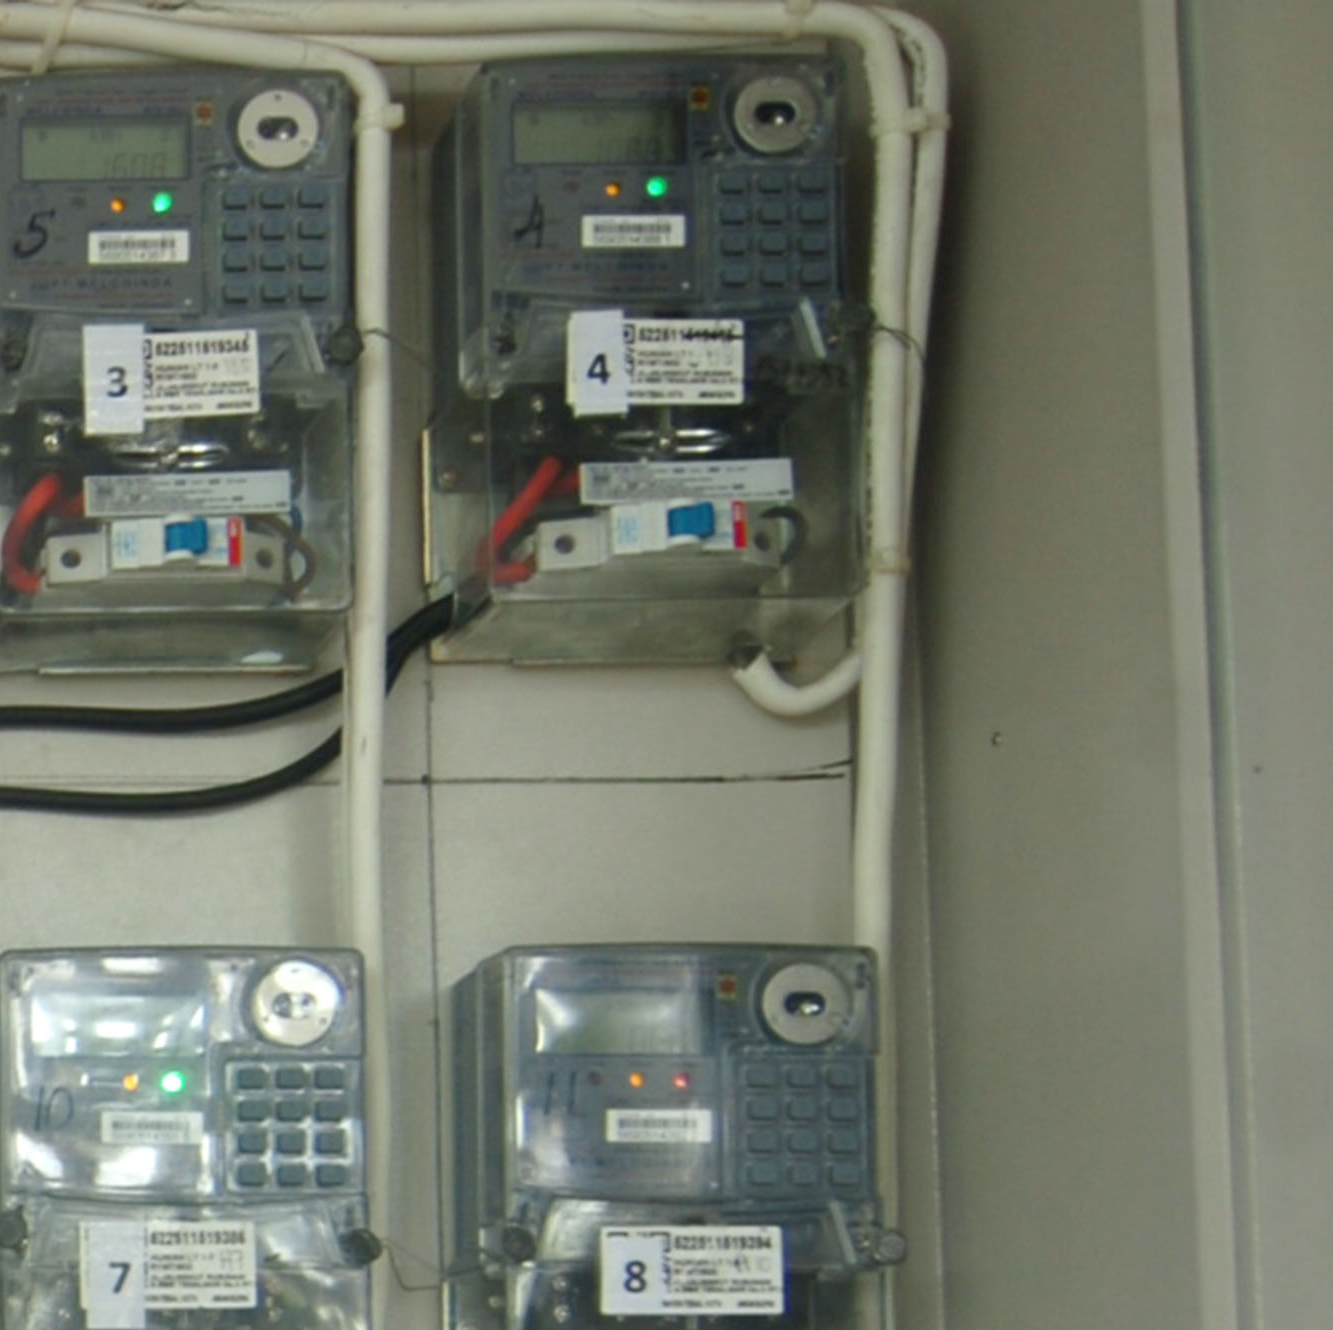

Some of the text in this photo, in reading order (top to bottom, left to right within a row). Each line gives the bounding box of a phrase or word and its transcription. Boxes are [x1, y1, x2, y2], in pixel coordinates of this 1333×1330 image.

[12, 208, 56, 258] 5
[105, 366, 129, 398] 3
[586, 353, 612, 386] 4
[107, 1262, 132, 1294] 7
[623, 1260, 647, 1293] 8
